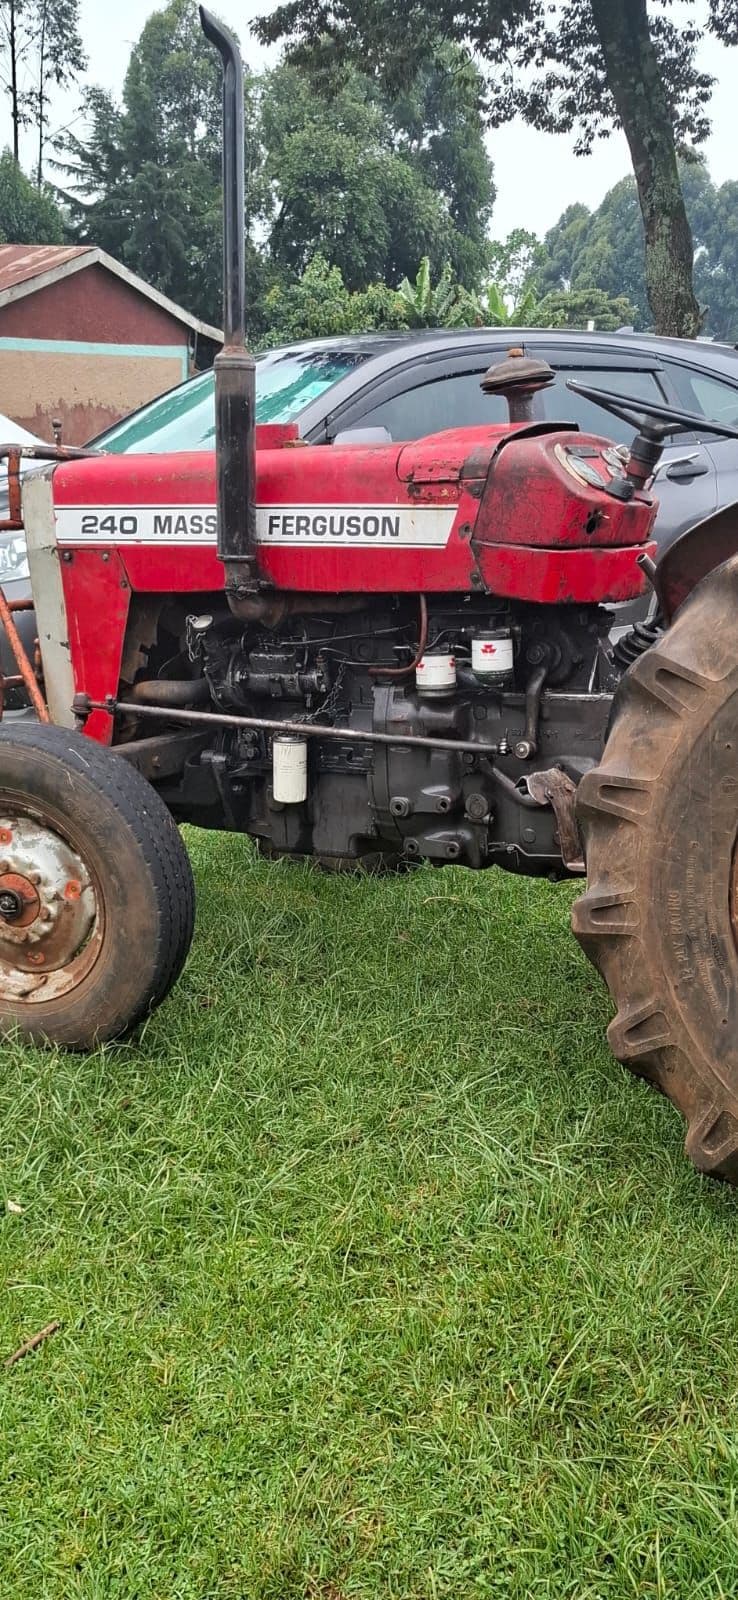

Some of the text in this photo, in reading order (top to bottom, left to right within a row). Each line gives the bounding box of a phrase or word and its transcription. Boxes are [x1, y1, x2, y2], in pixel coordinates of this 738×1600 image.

[81, 515, 400, 537] 240 MASS FERGUSON
[668, 891, 683, 935] RATING
[672, 941, 689, 961] PLY
